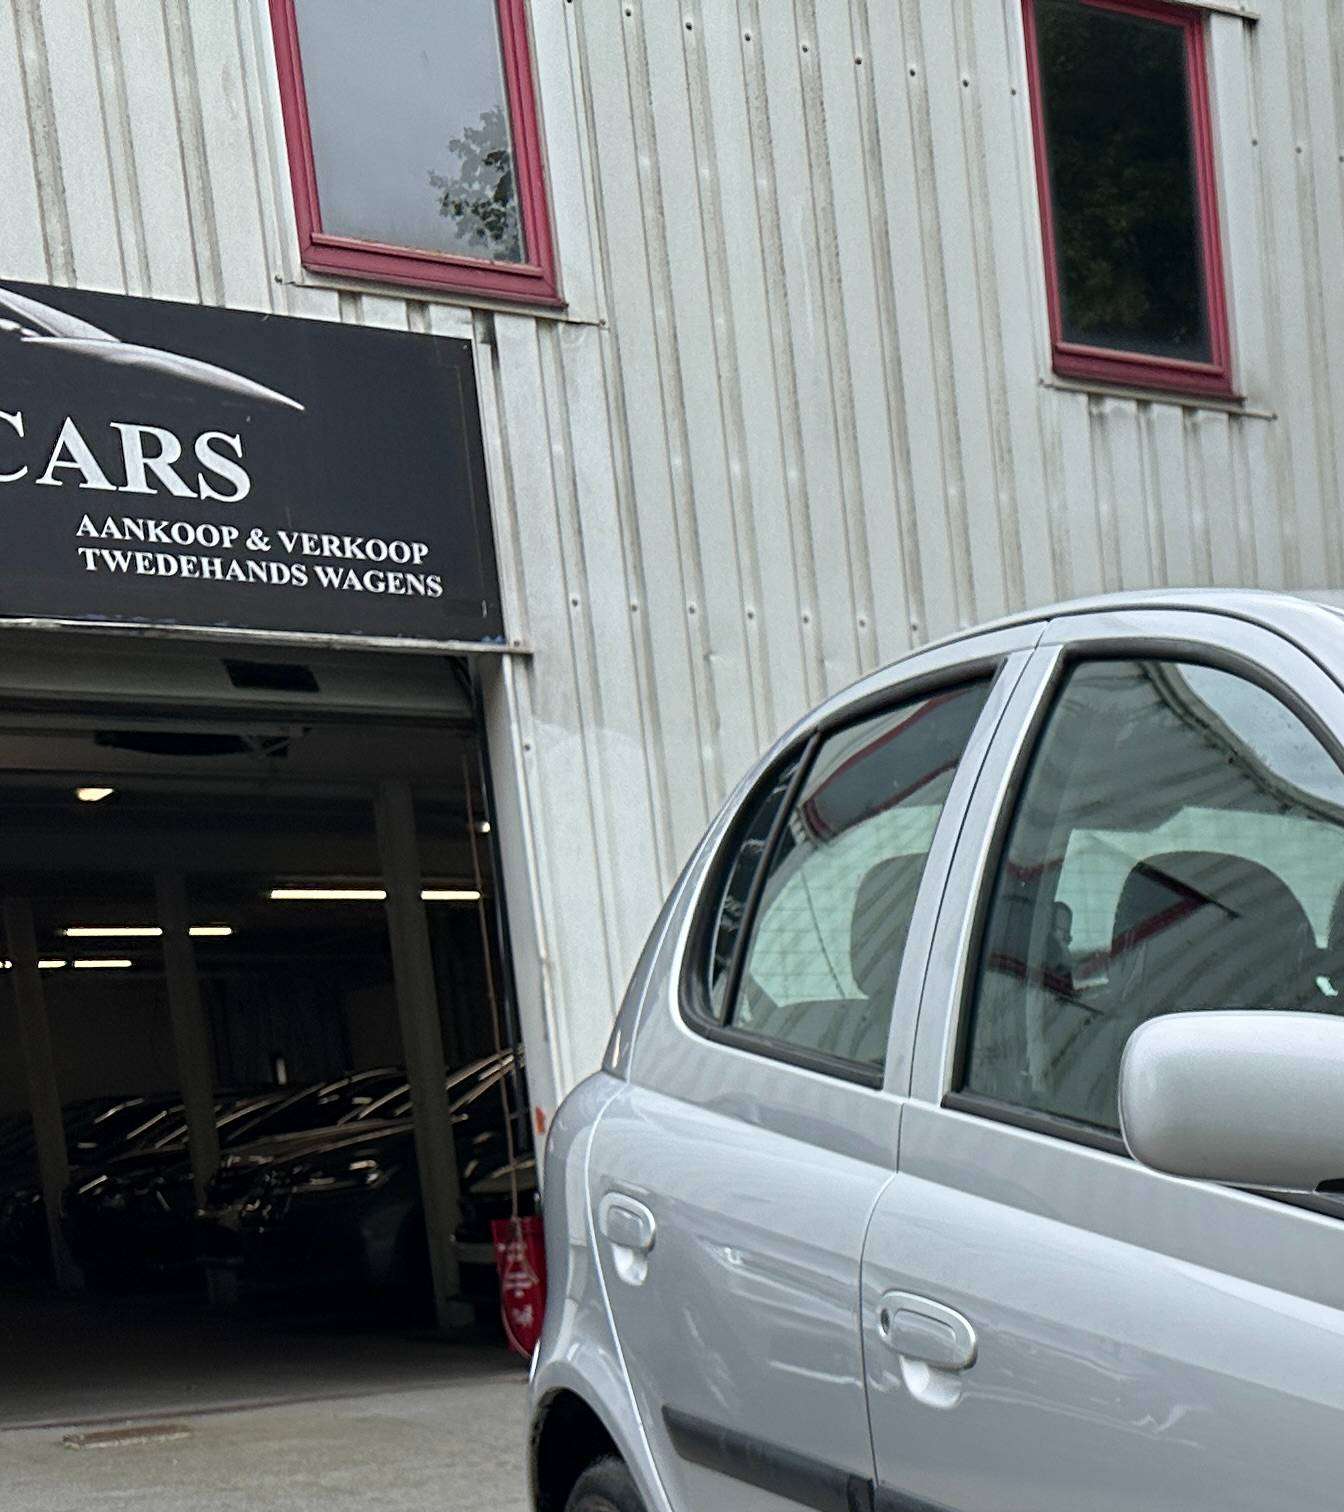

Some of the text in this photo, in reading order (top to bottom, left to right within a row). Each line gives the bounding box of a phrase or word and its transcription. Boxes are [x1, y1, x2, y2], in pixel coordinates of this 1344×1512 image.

[76, 514, 429, 566] AANKOOP & VERKOOP
[78, 547, 443, 597] TWEDEHANDS WAGENS
